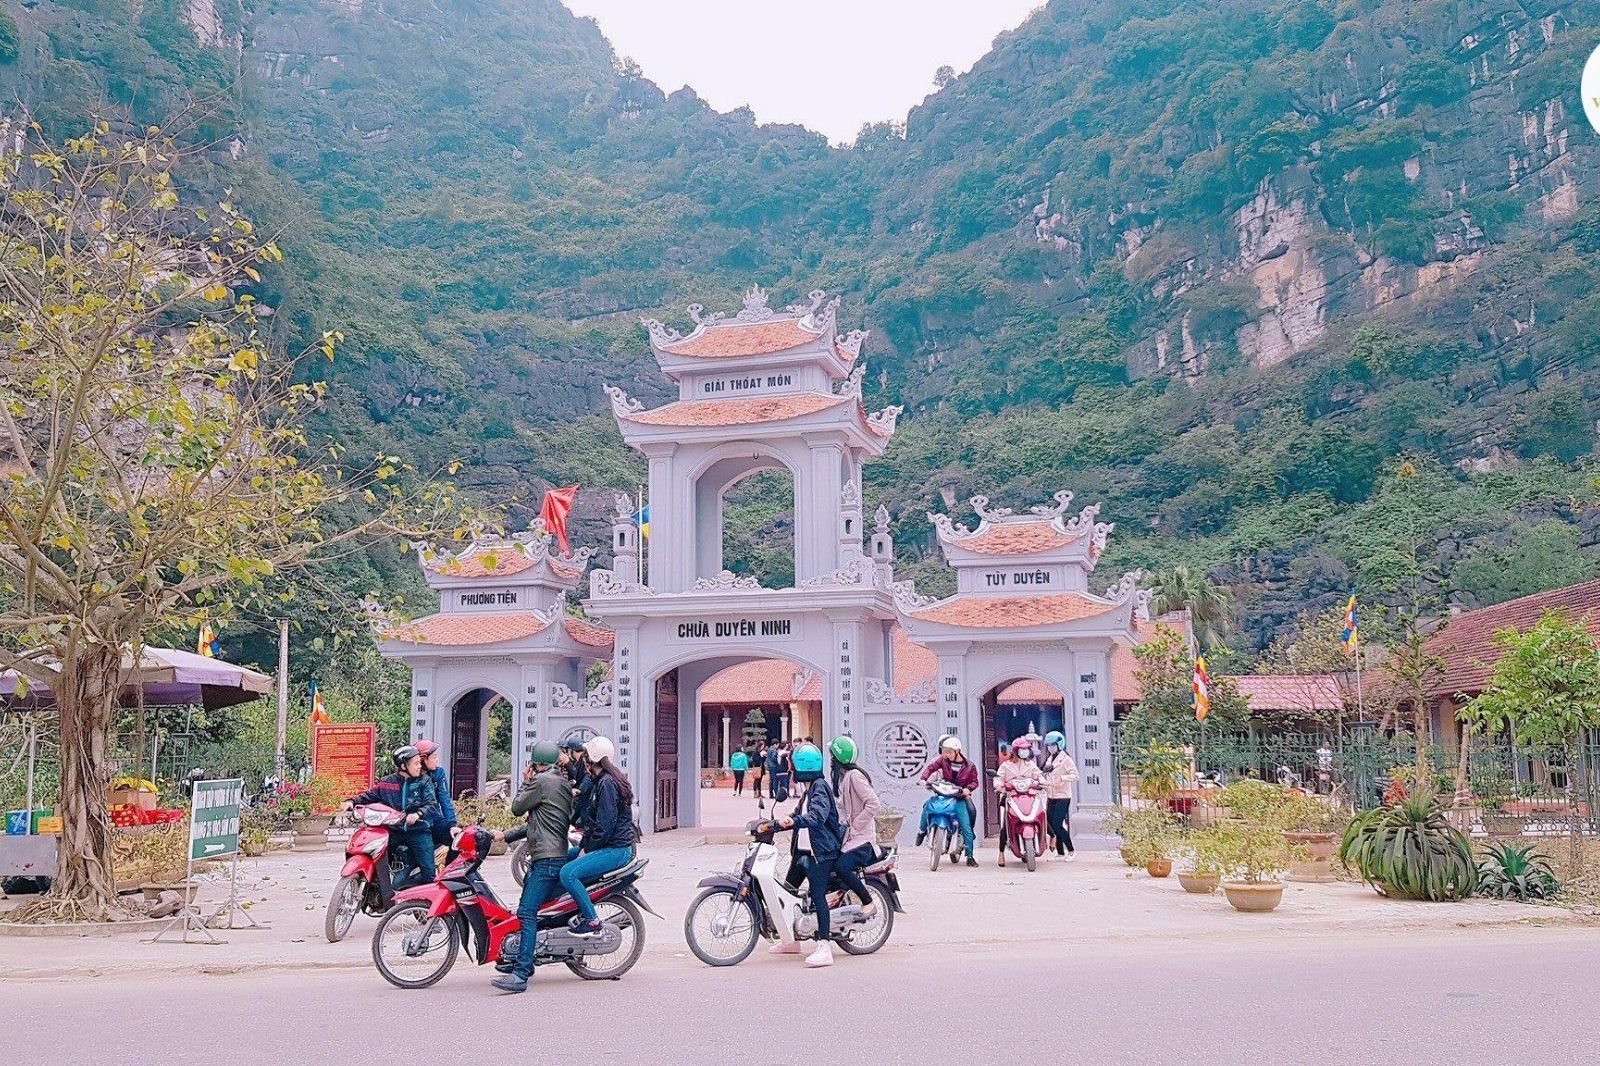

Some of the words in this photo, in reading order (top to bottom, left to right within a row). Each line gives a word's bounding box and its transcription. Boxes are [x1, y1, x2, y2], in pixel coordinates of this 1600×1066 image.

[704, 379, 725, 392] GIẢI
[1014, 569, 1050, 584] DUYÊN
[461, 592, 495, 605] PHƯƠNG
[497, 589, 517, 606] TIỆN
[678, 621, 710, 638] CHÙA
[715, 619, 756, 637] DUYÊN
[761, 620, 791, 636] NINH
